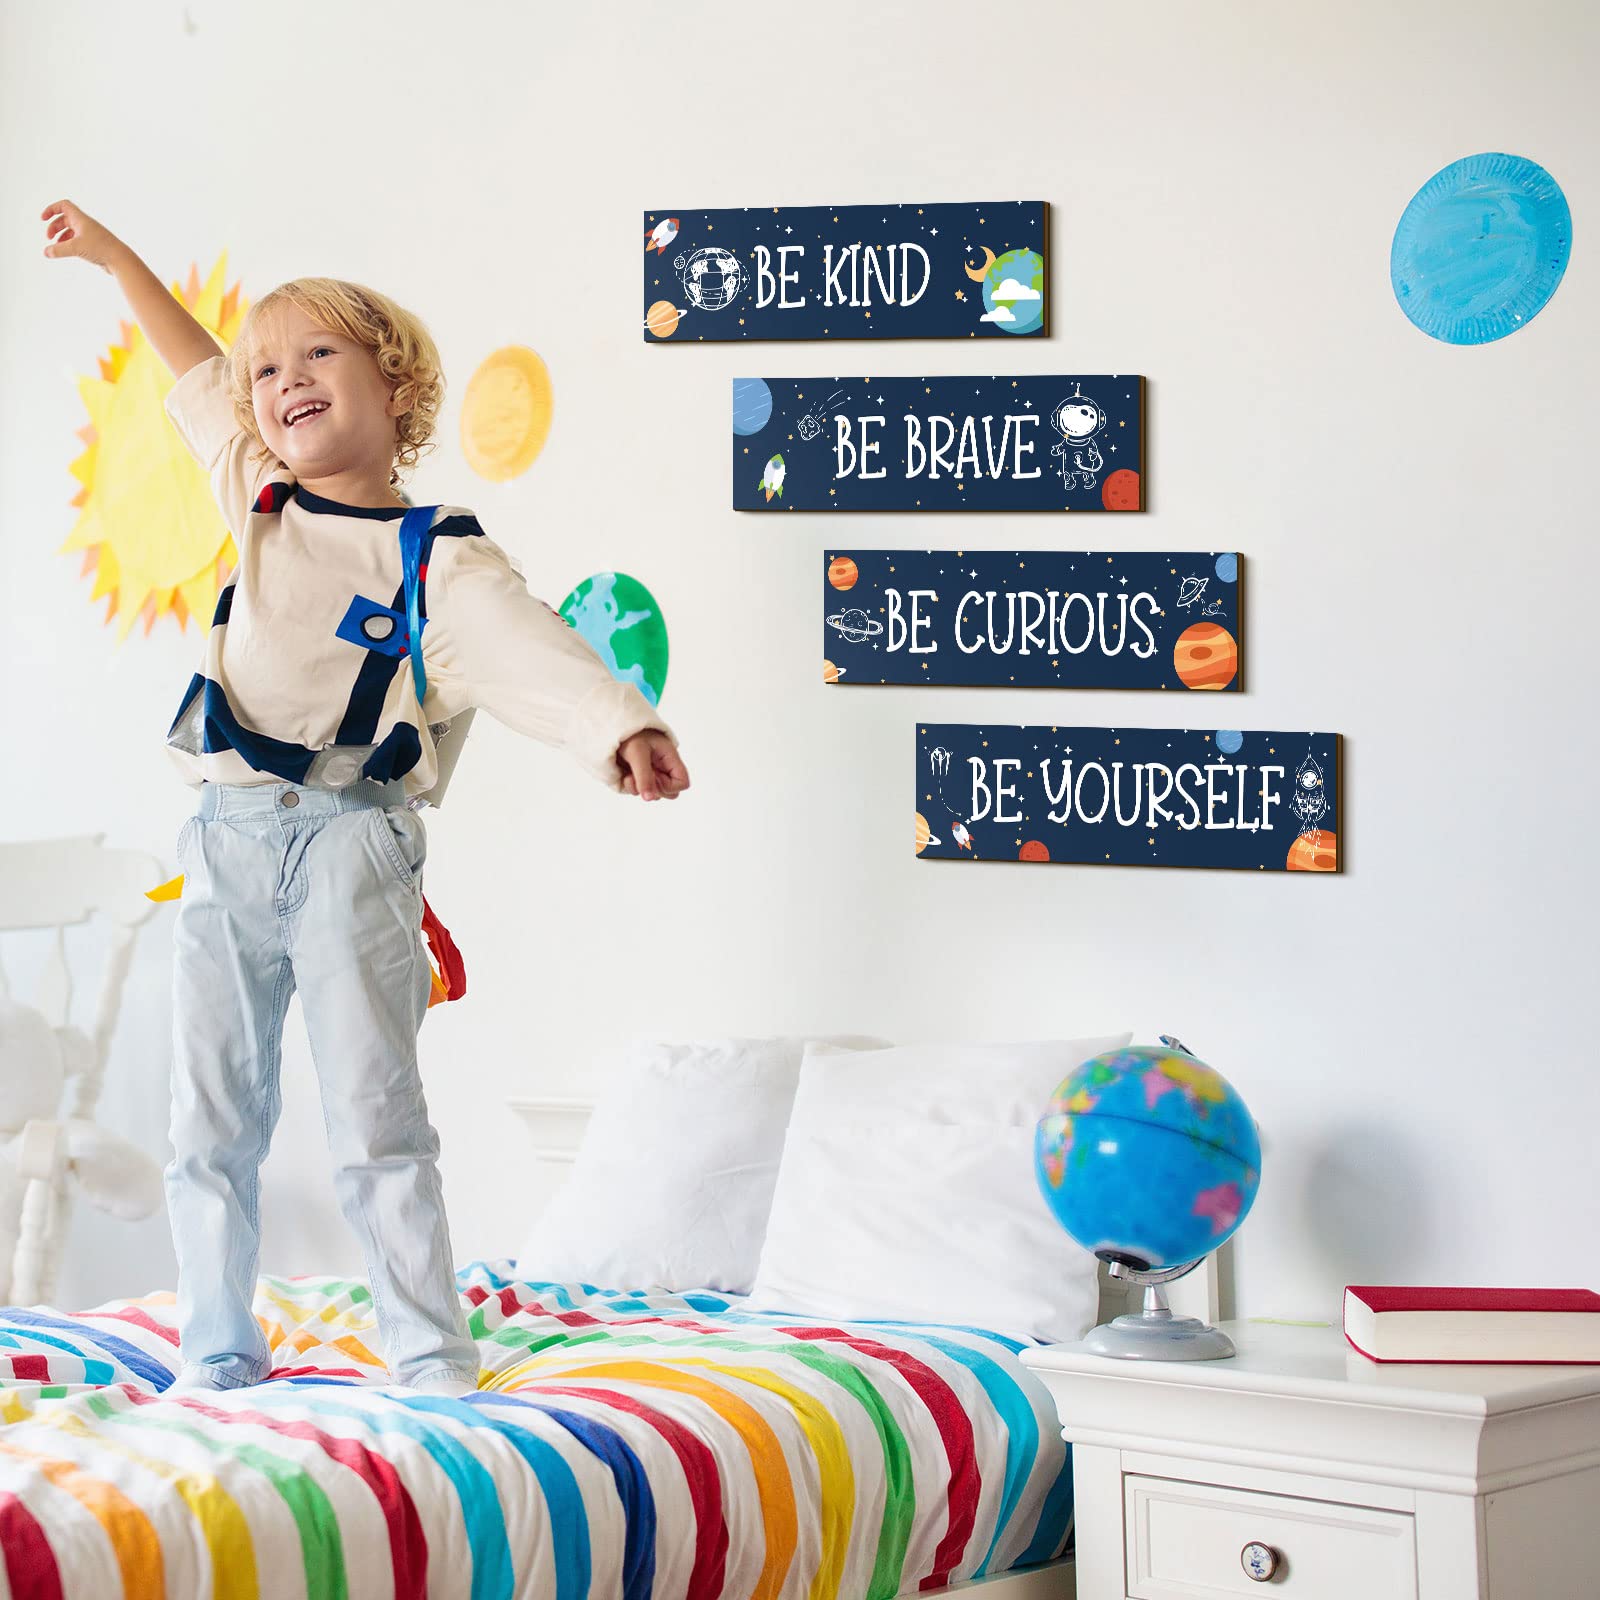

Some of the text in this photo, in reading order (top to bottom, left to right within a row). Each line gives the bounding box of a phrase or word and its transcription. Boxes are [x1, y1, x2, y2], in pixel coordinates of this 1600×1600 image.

[754, 242, 931, 309] BE KIND
[833, 414, 1041, 480] BE BRAVE
[885, 588, 1161, 658] BE CURIOUS
[966, 757, 1285, 831] BE YOURSELF
